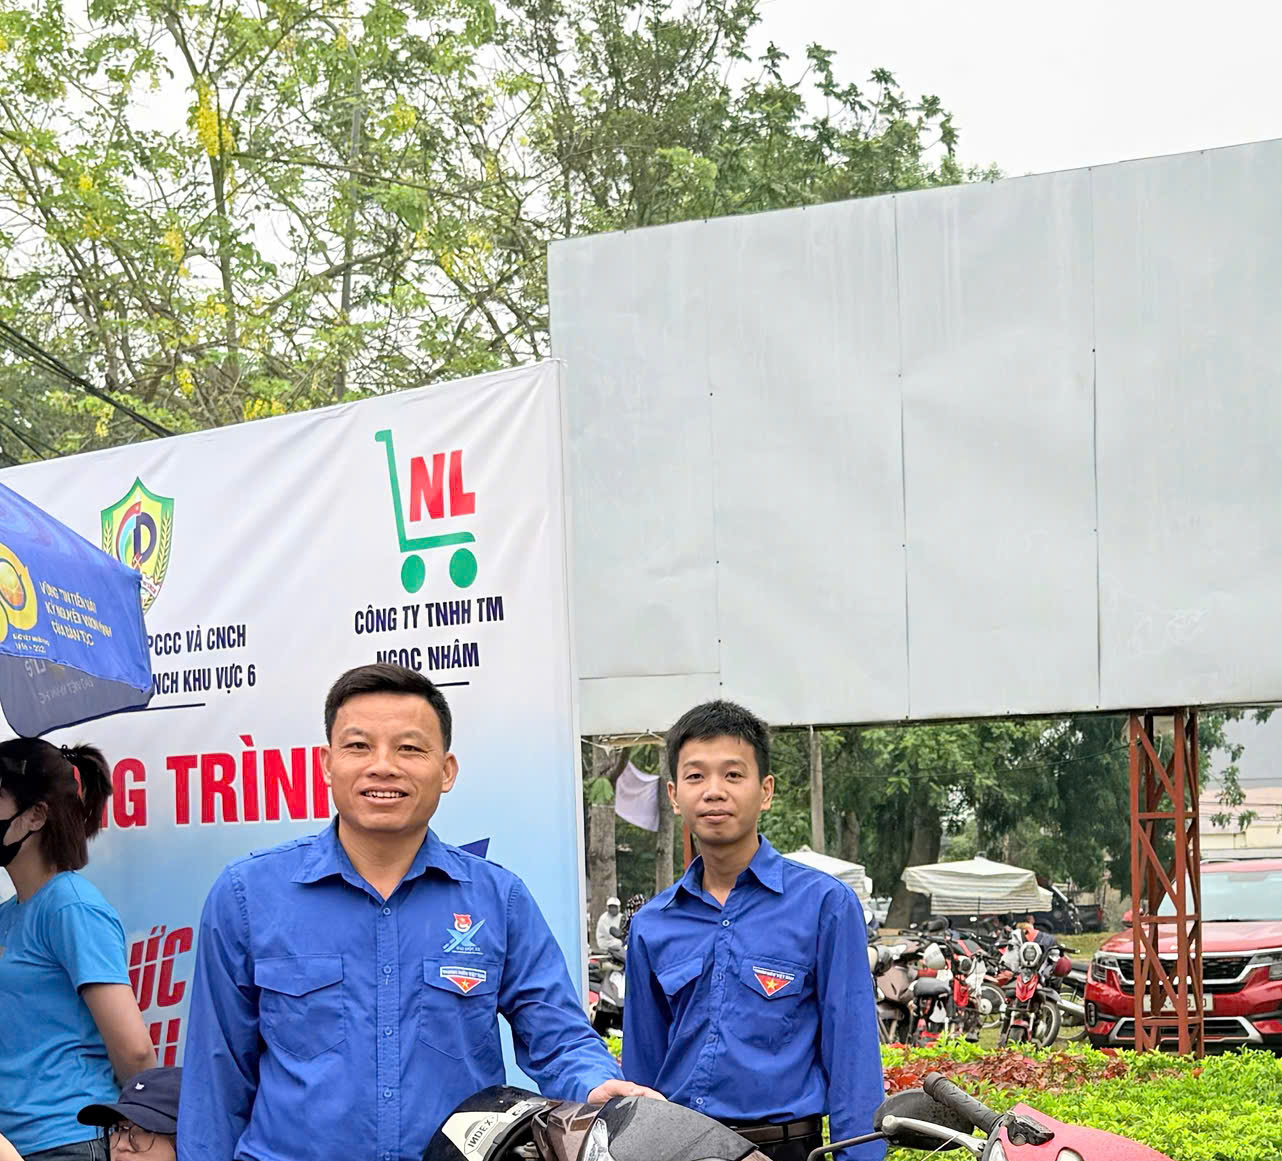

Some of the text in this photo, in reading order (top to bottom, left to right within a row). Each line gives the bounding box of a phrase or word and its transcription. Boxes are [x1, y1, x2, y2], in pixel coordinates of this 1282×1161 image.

[409, 449, 476, 522] NL
[354, 596, 504, 634] CÔNG TY TNHH TM
[186, 624, 202, 653] VÀ
[206, 624, 246, 650] CNCH
[427, 638, 480, 671] NHÂM
[183, 667, 211, 692] KHU
[216, 663, 243, 694] VỰC
[247, 664, 256, 687] 6
